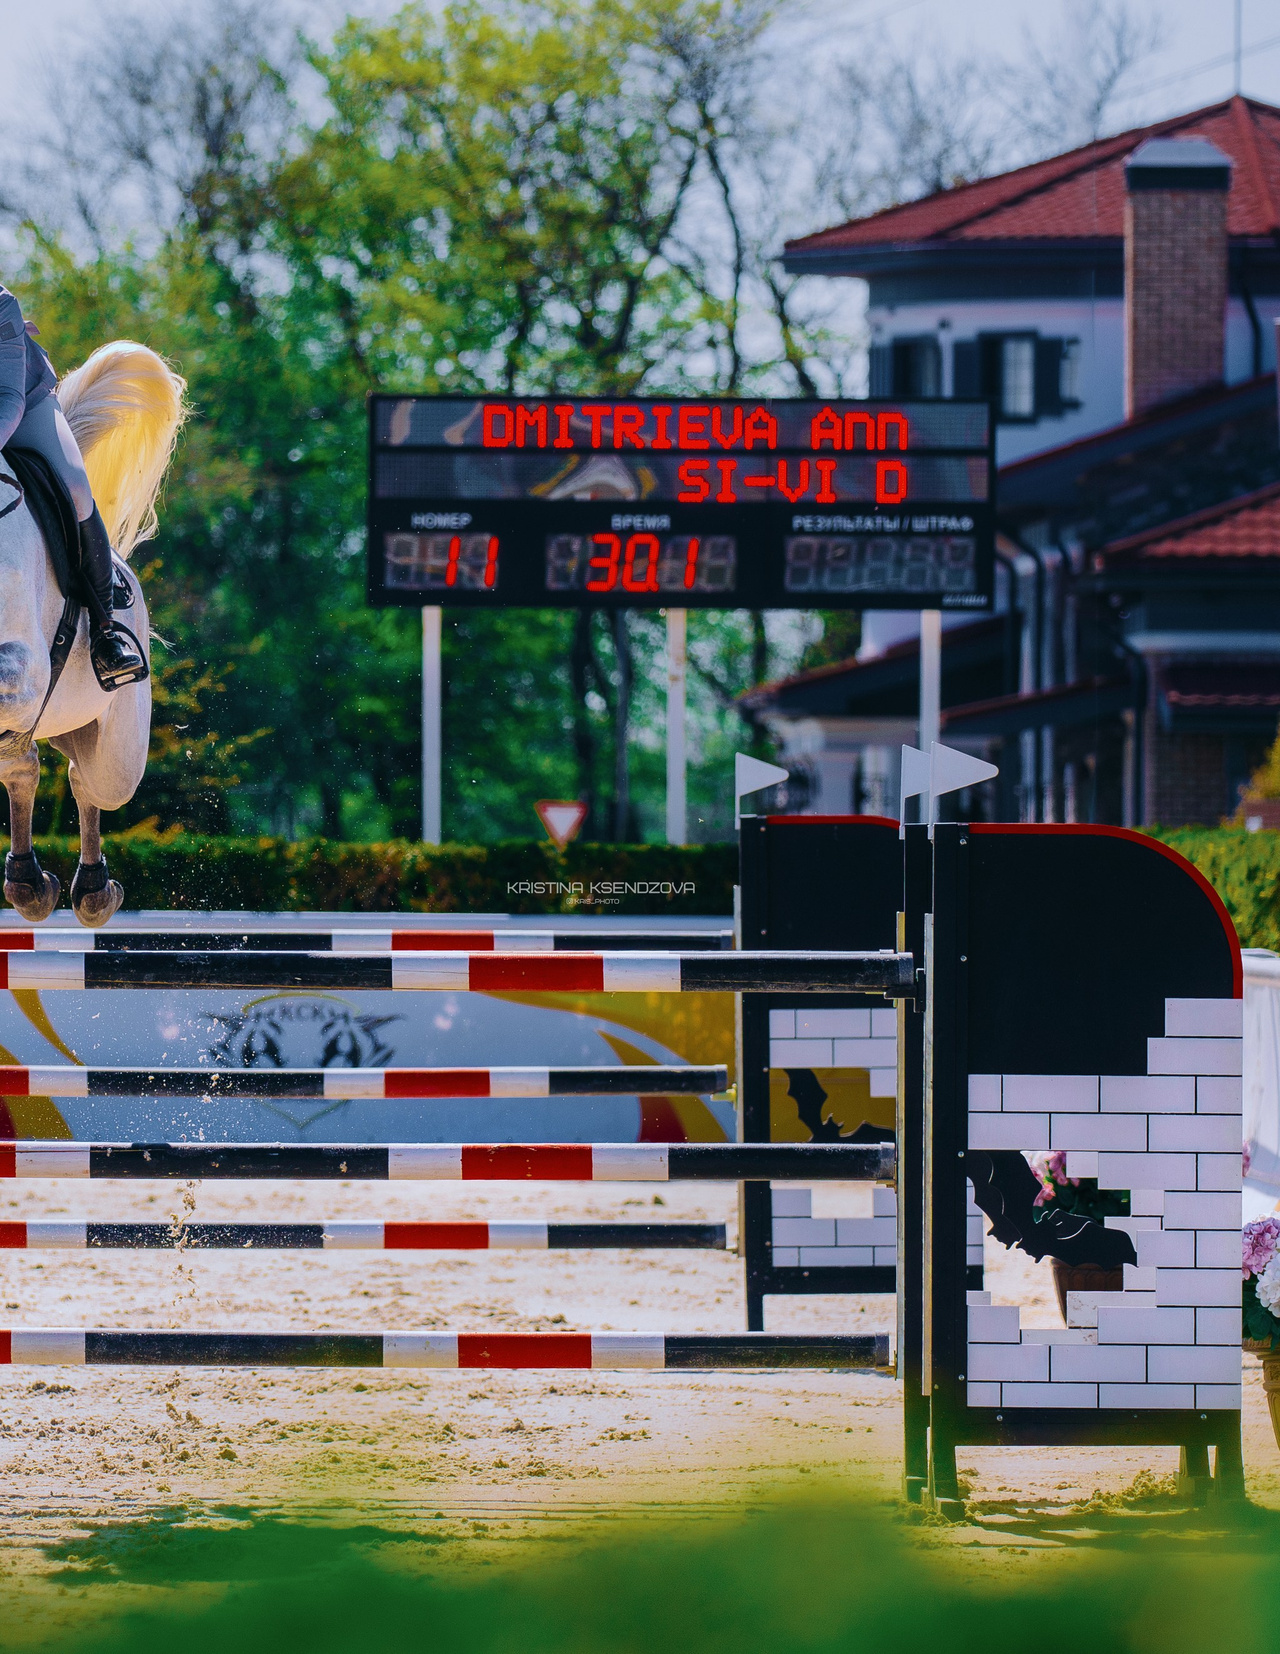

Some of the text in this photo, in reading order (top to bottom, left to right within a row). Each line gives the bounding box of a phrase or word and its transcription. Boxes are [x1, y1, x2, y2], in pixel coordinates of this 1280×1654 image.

[482, 404, 778, 450] DMITRIEVA
[677, 458, 908, 504] SI-VI D
[411, 512, 472, 529] НОМЕР
[611, 514, 670, 530] ВРЕМЯ
[792, 515, 900, 532] РЕЗУЛЬТАТЫ
[911, 515, 974, 532] ШТРАФ
[445, 535, 499, 587] 11
